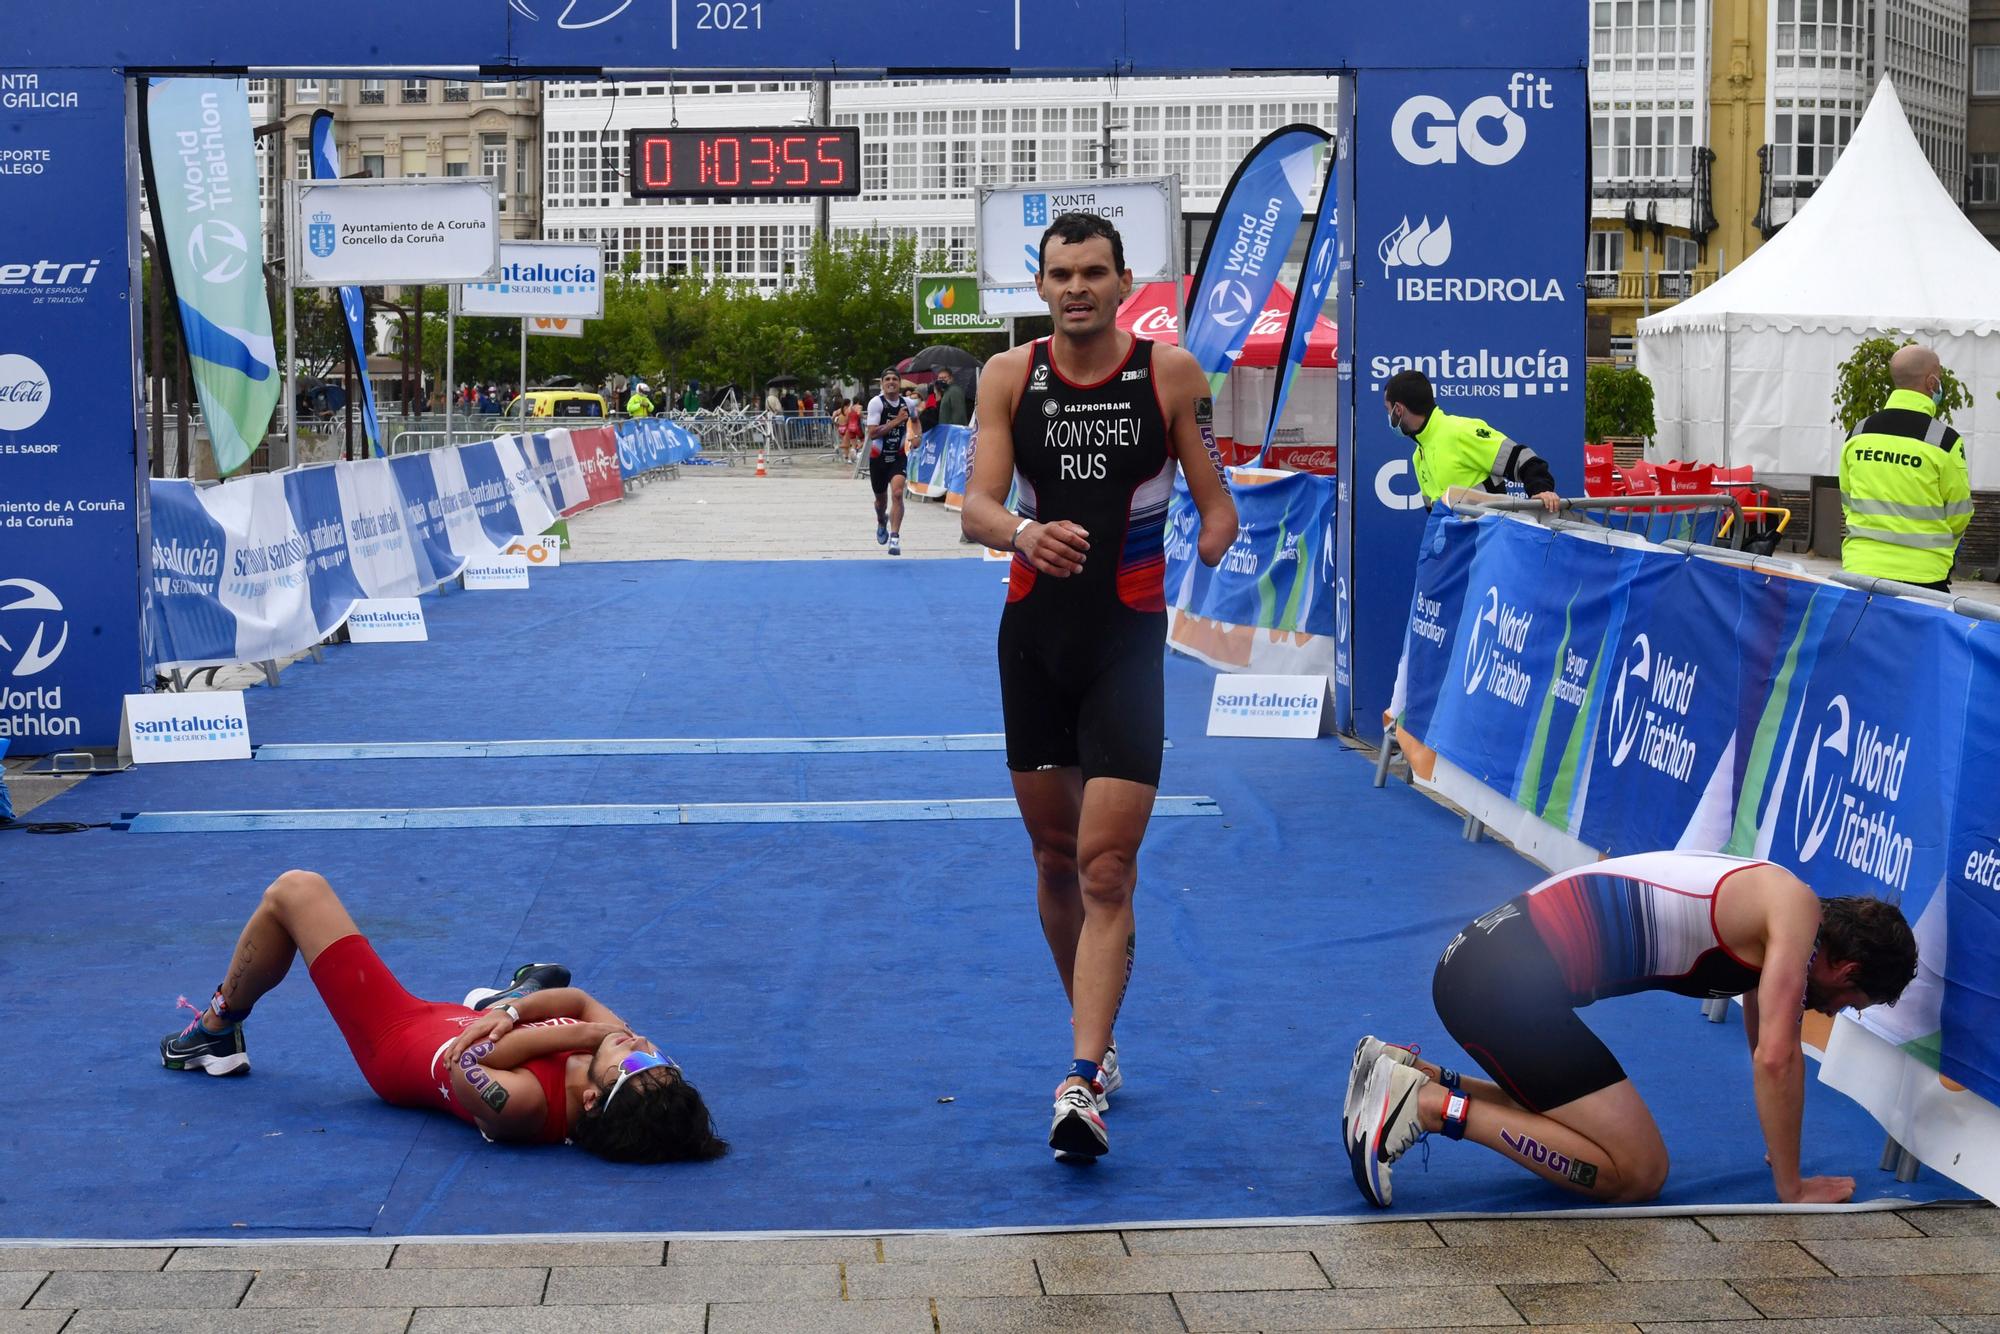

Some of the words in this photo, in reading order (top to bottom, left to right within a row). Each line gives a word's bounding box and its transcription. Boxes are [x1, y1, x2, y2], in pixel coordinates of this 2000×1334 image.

[696, 3, 763, 30] 2021
[1, 74, 38, 89] NTA
[3, 92, 78, 108] GALICIA
[1391, 95, 1526, 165] GO
[1508, 72, 1554, 108] fit
[200, 93, 233, 210] Triathlon
[176, 131, 207, 213] World
[1052, 194, 1095, 207] XUNTA
[342, 221, 418, 234] Ayuntamiento
[421, 220, 435, 231] de
[437, 221, 445, 230] A
[448, 218, 486, 230] Coruña
[1241, 198, 1282, 277] Triathlon
[342, 234, 387, 245] Concello
[390, 233, 404, 244] da
[406, 232, 444, 244] Coruña
[1223, 213, 1257, 271] World
[0, 260, 100, 284] etri
[46, 286, 87, 294] ESPAÑOLA
[512, 285, 551, 294] SEGUROS
[1397, 278, 1565, 301] IBERDROLA
[1371, 349, 1568, 379] santalucía
[1440, 384, 1501, 397] SEGUROS
[1064, 402, 1131, 412] GAZPROMBANK
[1044, 418, 1141, 447] KONYSHEV
[21, 445, 58, 453] SABOR
[1855, 447, 1923, 468] TÉCNICO
[1061, 453, 1107, 480] RUS
[44, 500, 61, 511] de
[64, 501, 74, 511] A
[78, 499, 125, 511] Coruña
[6, 516, 27, 527] da
[28, 514, 73, 527] Coruña
[543, 537, 556, 548] fit
[1424, 599, 1442, 619] your
[1497, 602, 1533, 654] World
[1566, 648, 1575, 673] Be
[1571, 656, 1588, 680] your
[1486, 650, 1531, 707] Triathlon
[1651, 652, 1698, 715] World
[1638, 710, 1697, 783] Triathlon
[1850, 720, 1911, 802] World
[1833, 793, 1913, 891] Triathlon
